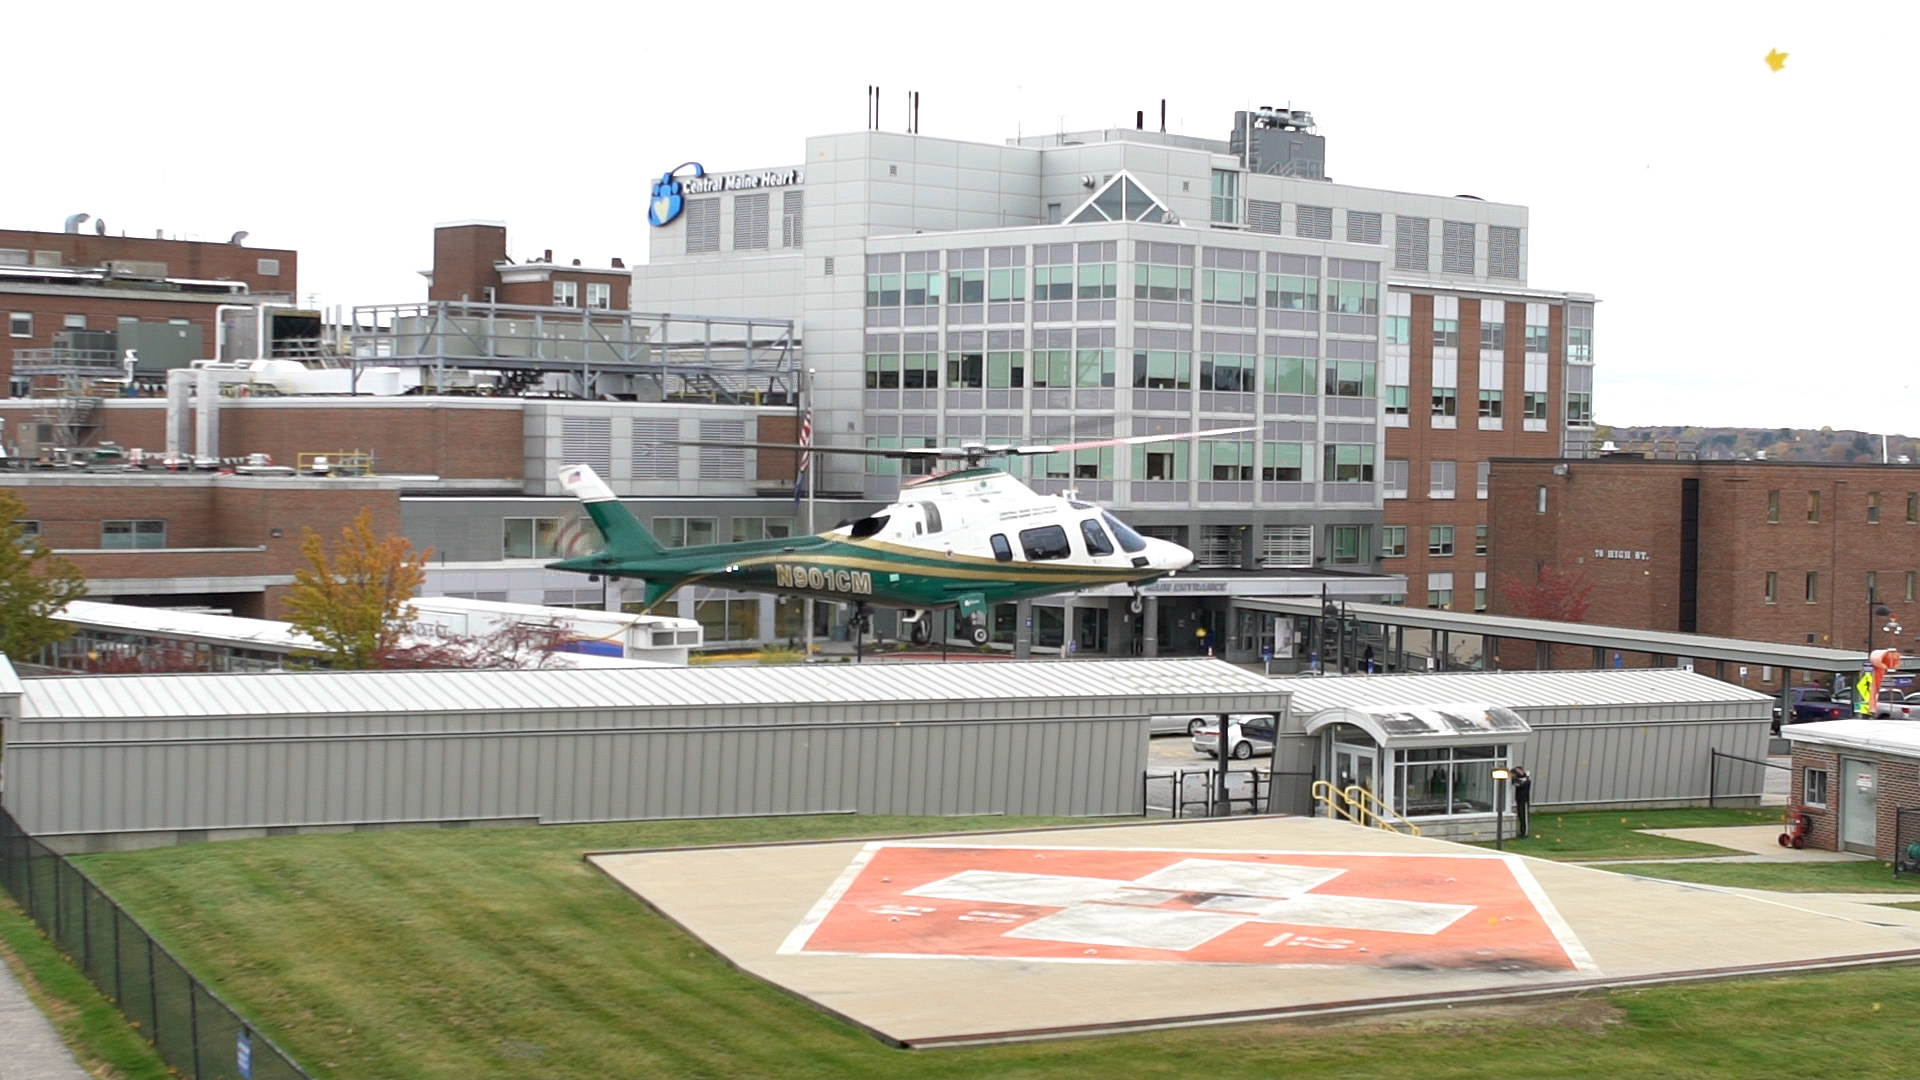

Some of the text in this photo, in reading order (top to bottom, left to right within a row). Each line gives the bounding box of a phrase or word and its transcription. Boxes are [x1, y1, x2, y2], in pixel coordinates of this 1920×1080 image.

[683, 177, 723, 194] Central
[725, 174, 758, 191] Maine
[761, 170, 794, 188] Heart
[1607, 550, 1631, 559] HIGH
[1634, 551, 1650, 560] ST.
[775, 564, 872, 594] N901CM
[1173, 583, 1228, 592] ENTRANCE
